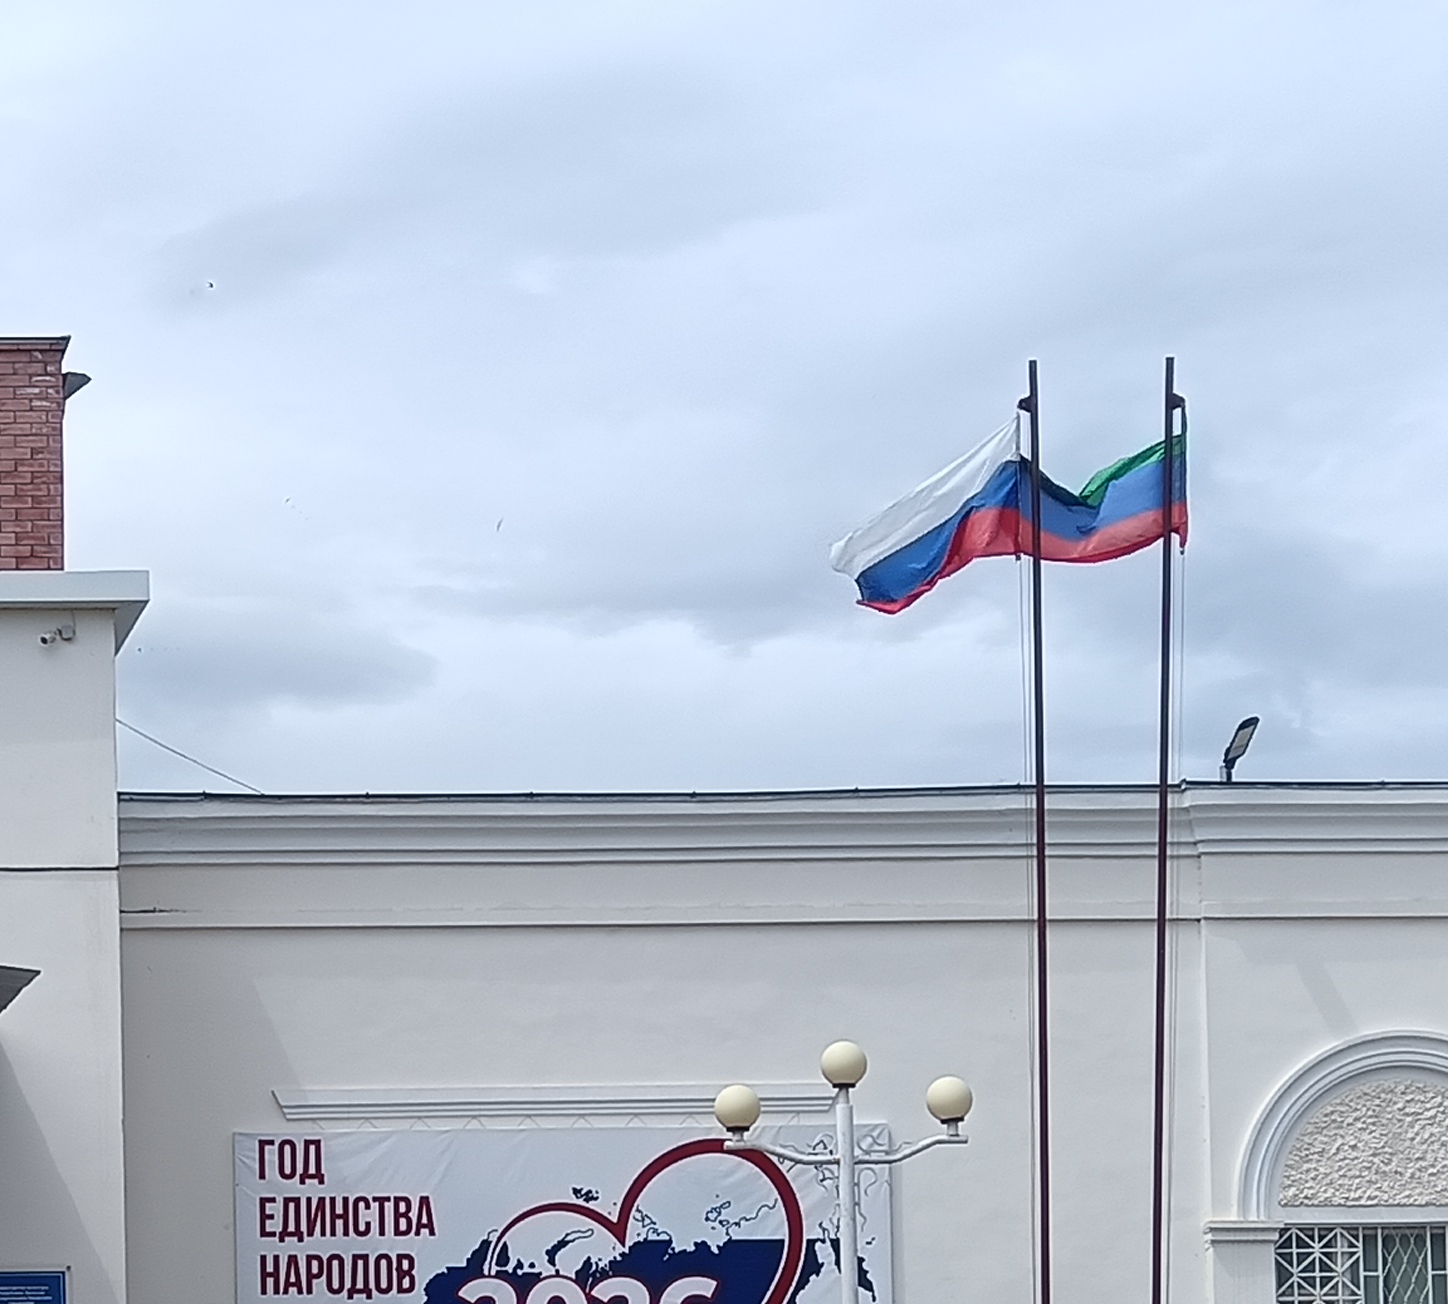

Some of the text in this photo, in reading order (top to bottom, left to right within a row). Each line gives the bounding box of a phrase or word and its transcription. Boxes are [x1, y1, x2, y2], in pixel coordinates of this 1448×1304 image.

[257, 1138, 326, 1186] ГОД
[258, 1195, 437, 1244] ЕДИНСТВА
[259, 1252, 417, 1301] НАРОДОВ
